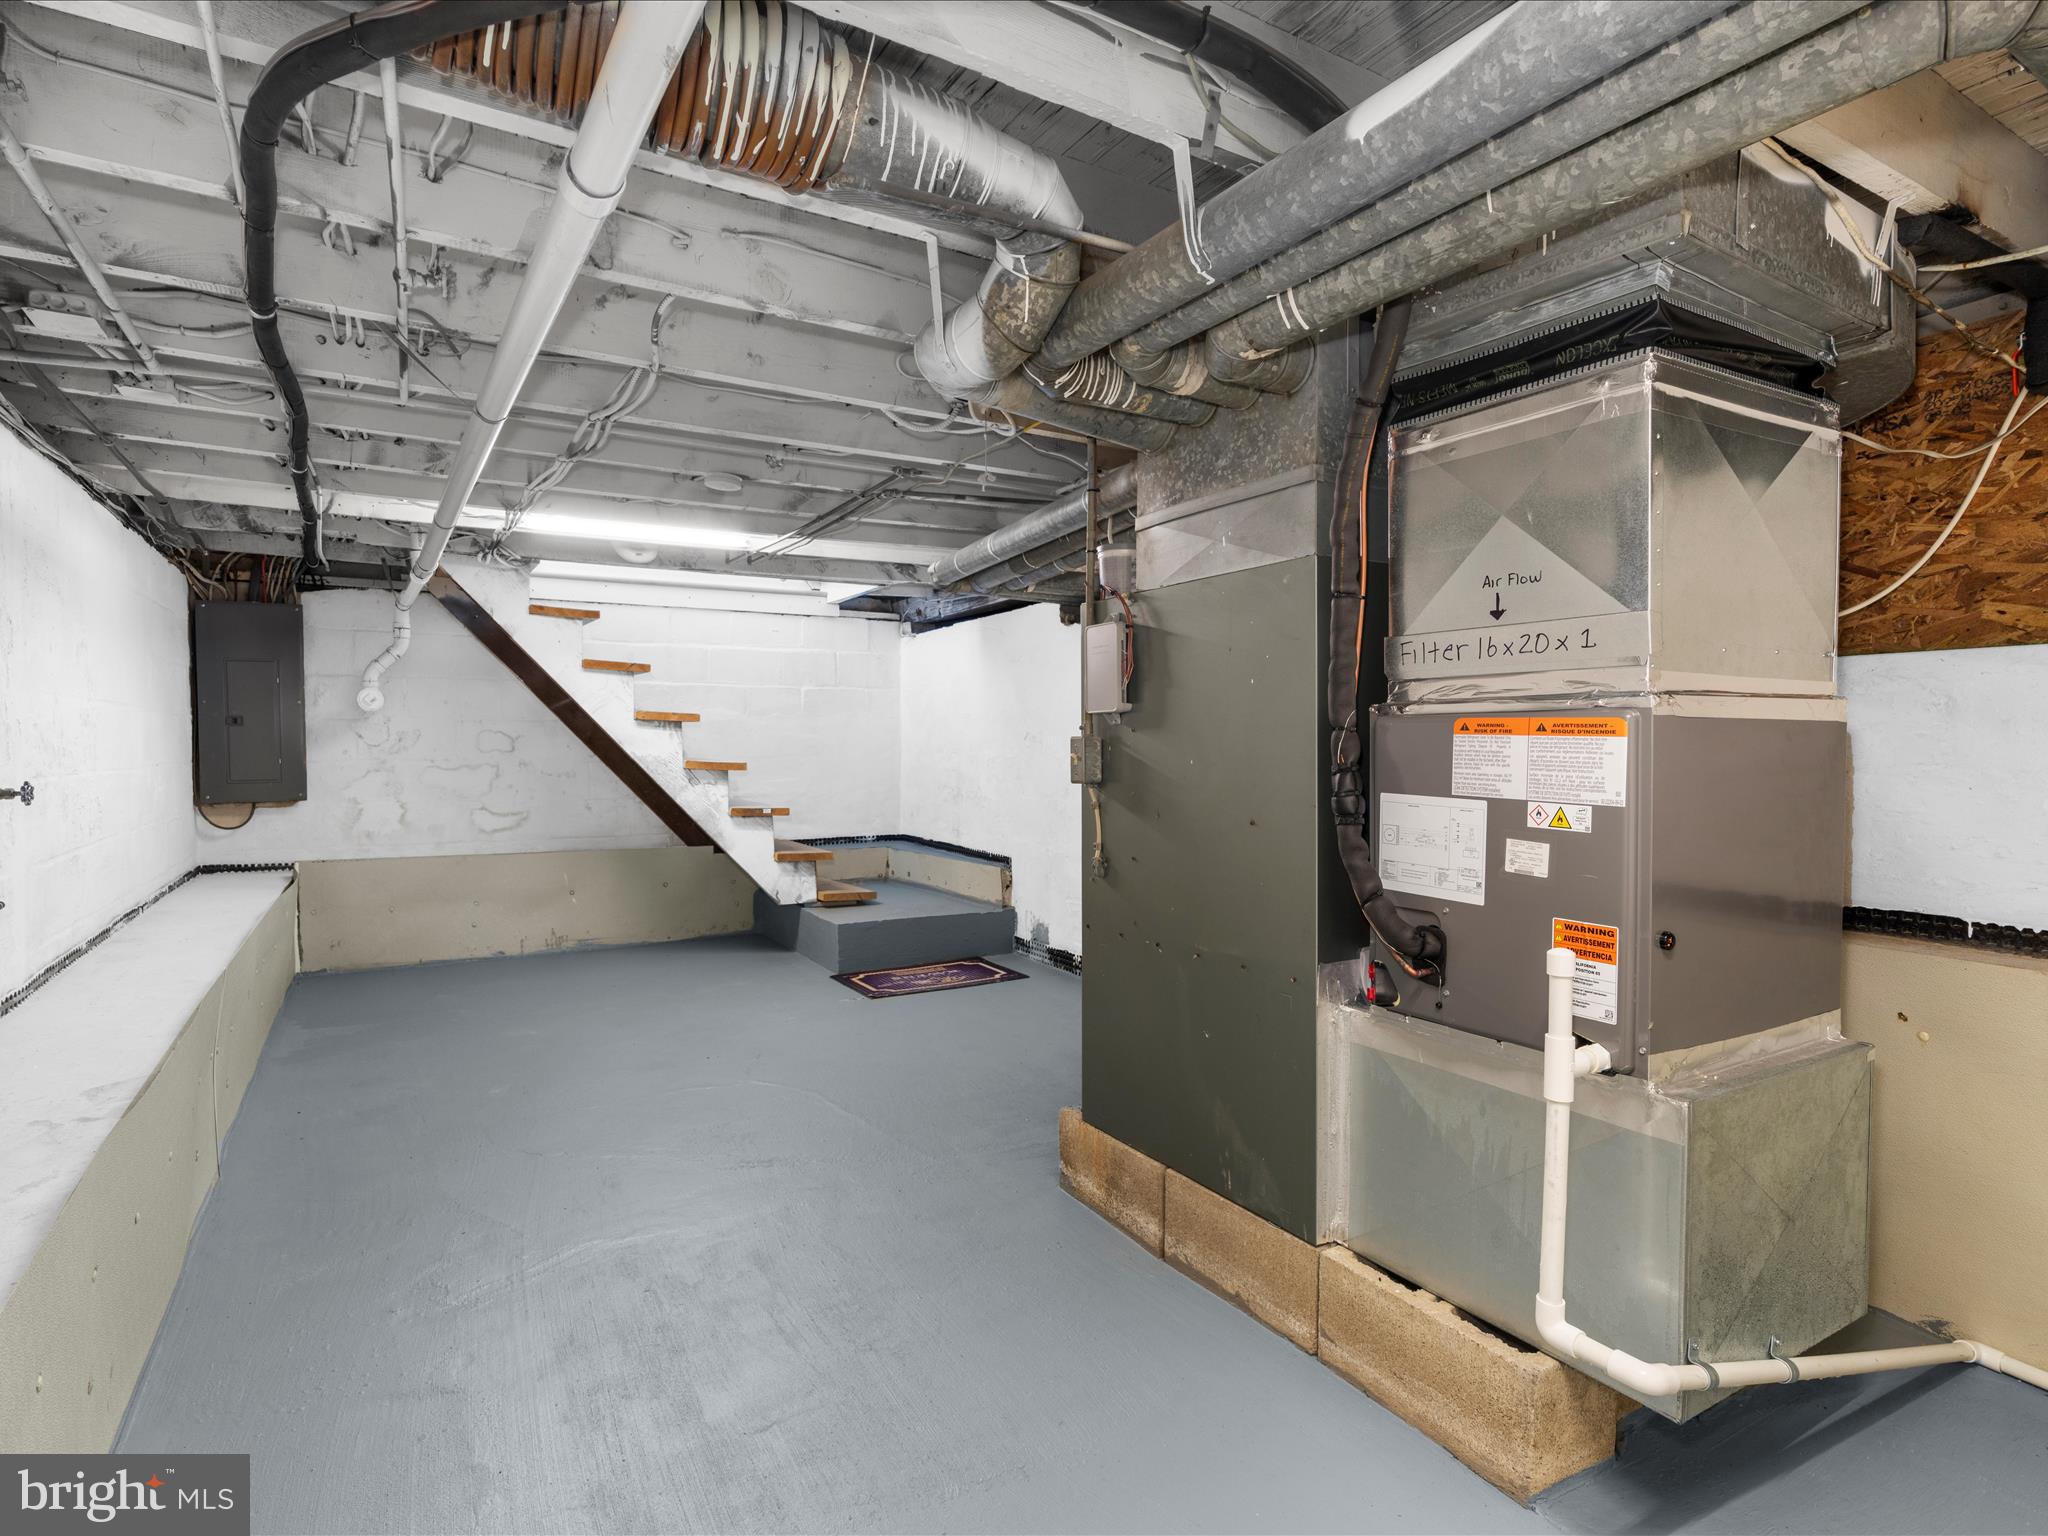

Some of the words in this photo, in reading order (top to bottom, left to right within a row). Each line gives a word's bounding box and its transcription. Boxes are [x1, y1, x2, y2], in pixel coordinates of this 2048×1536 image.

[1482, 575, 1502, 589] Air
[1508, 570, 1543, 586] Flow
[1400, 641, 1469, 666] Filter
[1564, 923, 1615, 938] WARNING
[1563, 934, 1616, 950] AVERTISSEMENT
[1567, 946, 1613, 962] DVERTENCIA
